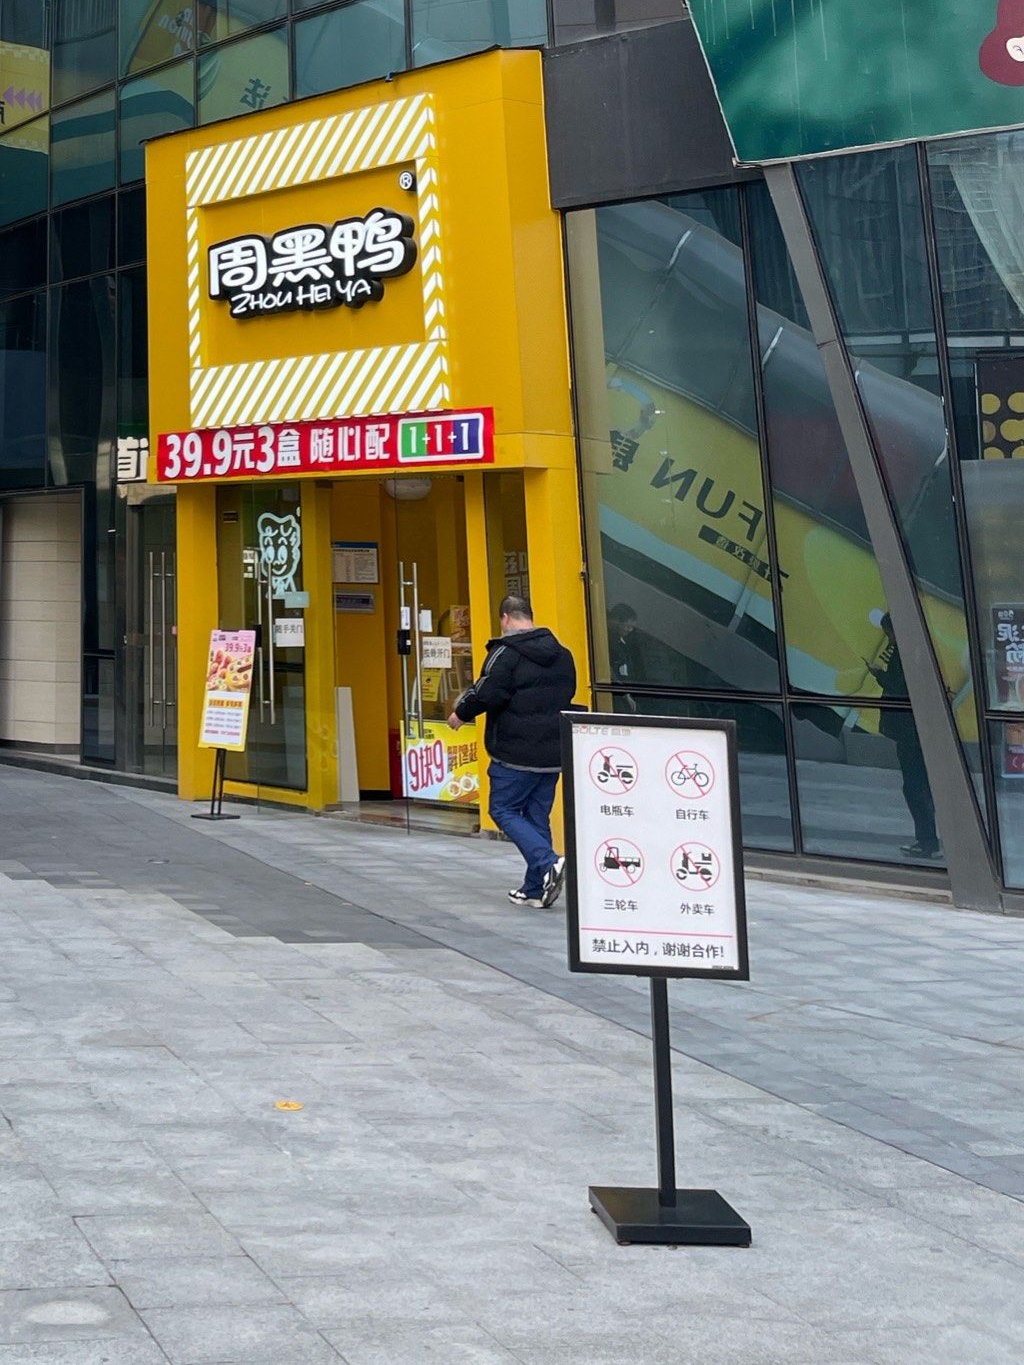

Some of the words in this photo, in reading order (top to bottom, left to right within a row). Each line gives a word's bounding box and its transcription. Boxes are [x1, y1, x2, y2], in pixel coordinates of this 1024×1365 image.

[208, 209, 408, 297] 周黑鸭
[231, 288, 292, 314] ZHOU
[335, 278, 372, 303] YA
[164, 426, 302, 478] 39.9元3盒
[310, 423, 390, 463] 随心配
[407, 421, 471, 454] 1+1+1
[600, 804, 634, 817] 电瓶车
[675, 808, 710, 821] 自行车
[604, 899, 638, 912] 三轮车
[680, 902, 715, 916] 外卖车
